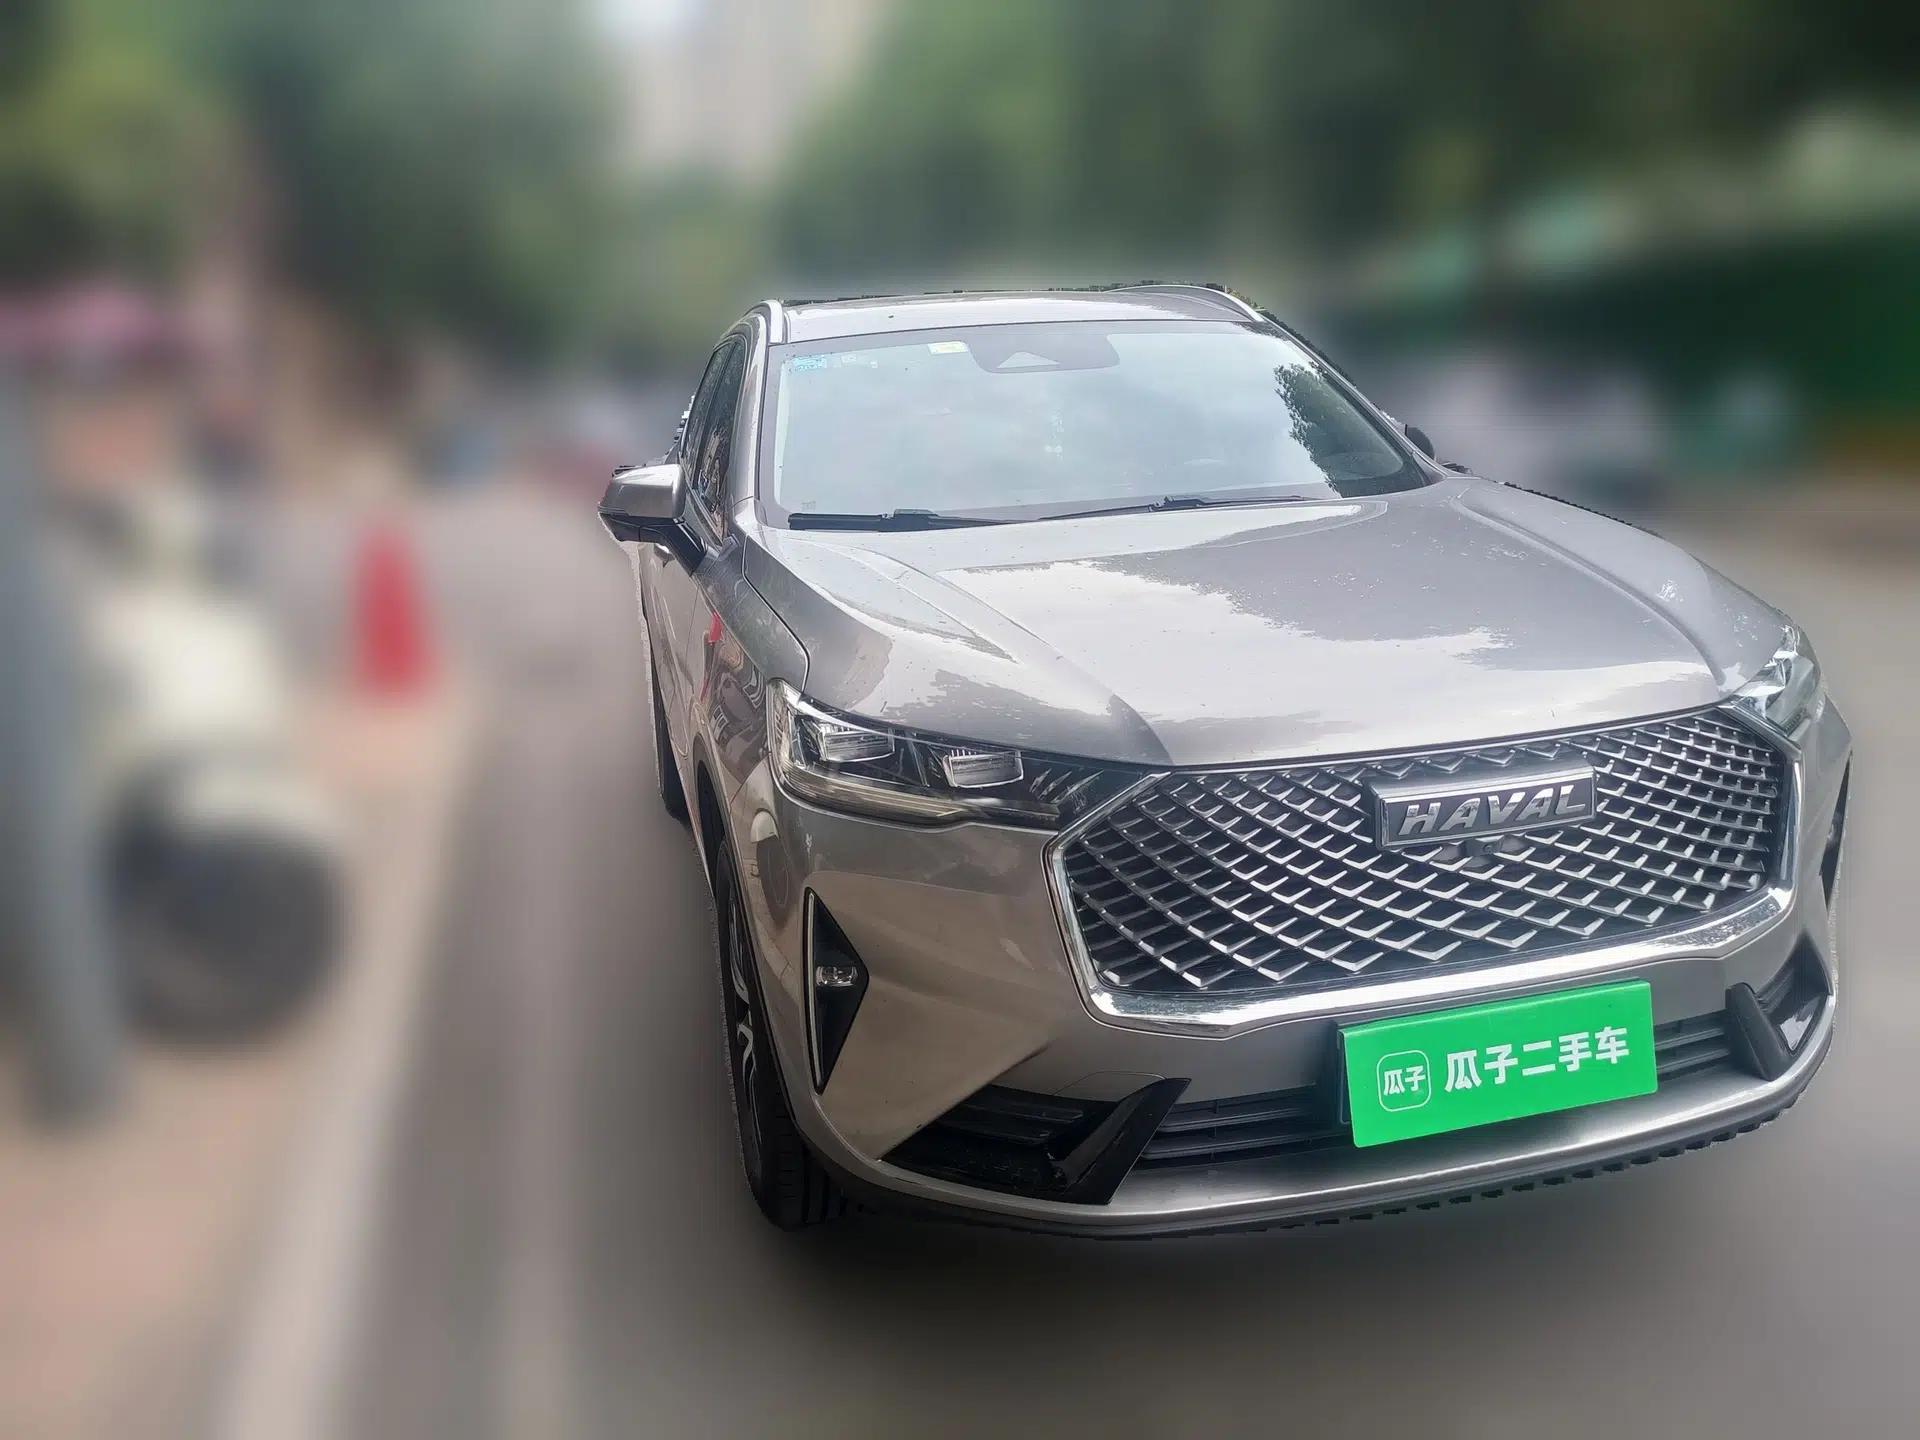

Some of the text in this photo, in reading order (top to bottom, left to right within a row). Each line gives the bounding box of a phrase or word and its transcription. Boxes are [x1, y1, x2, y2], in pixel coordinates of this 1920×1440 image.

[1399, 785, 1586, 835] HAVAL
[1383, 1065, 1426, 1096] 瓜子
[1444, 1026, 1630, 1092] 瓜子二手车
